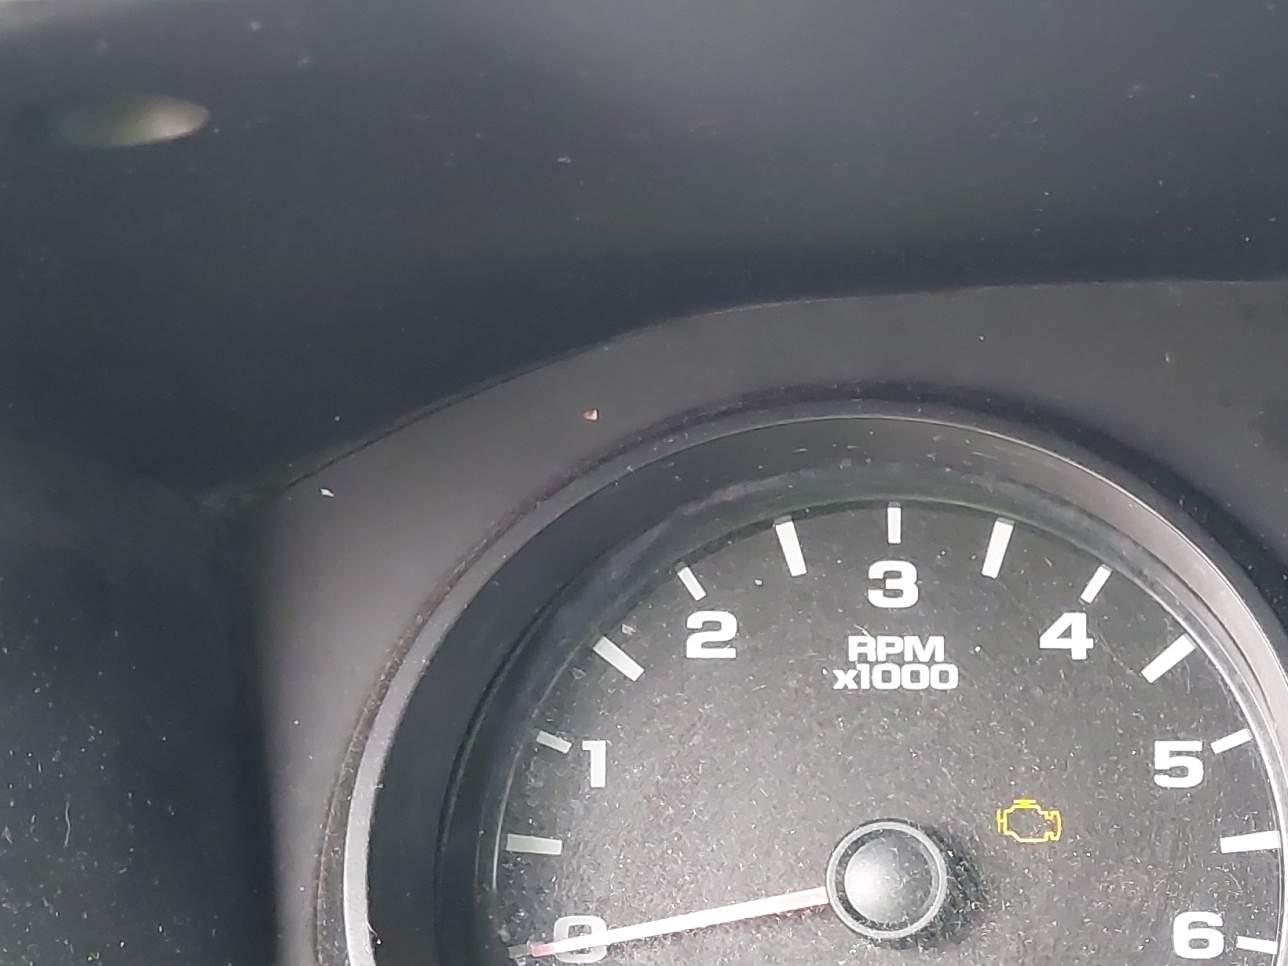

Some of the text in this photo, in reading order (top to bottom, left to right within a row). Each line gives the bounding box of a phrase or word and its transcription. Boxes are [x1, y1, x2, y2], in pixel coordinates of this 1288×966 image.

[867, 560, 919, 607] 3
[685, 610, 738, 659] 2
[847, 635, 945, 662] RPM
[1038, 612, 1094, 660] 4
[832, 663, 959, 690] x1000
[581, 740, 606, 788] 1
[1153, 740, 1204, 788] 5
[553, 915, 608, 963] 0
[1172, 911, 1224, 959] 6
